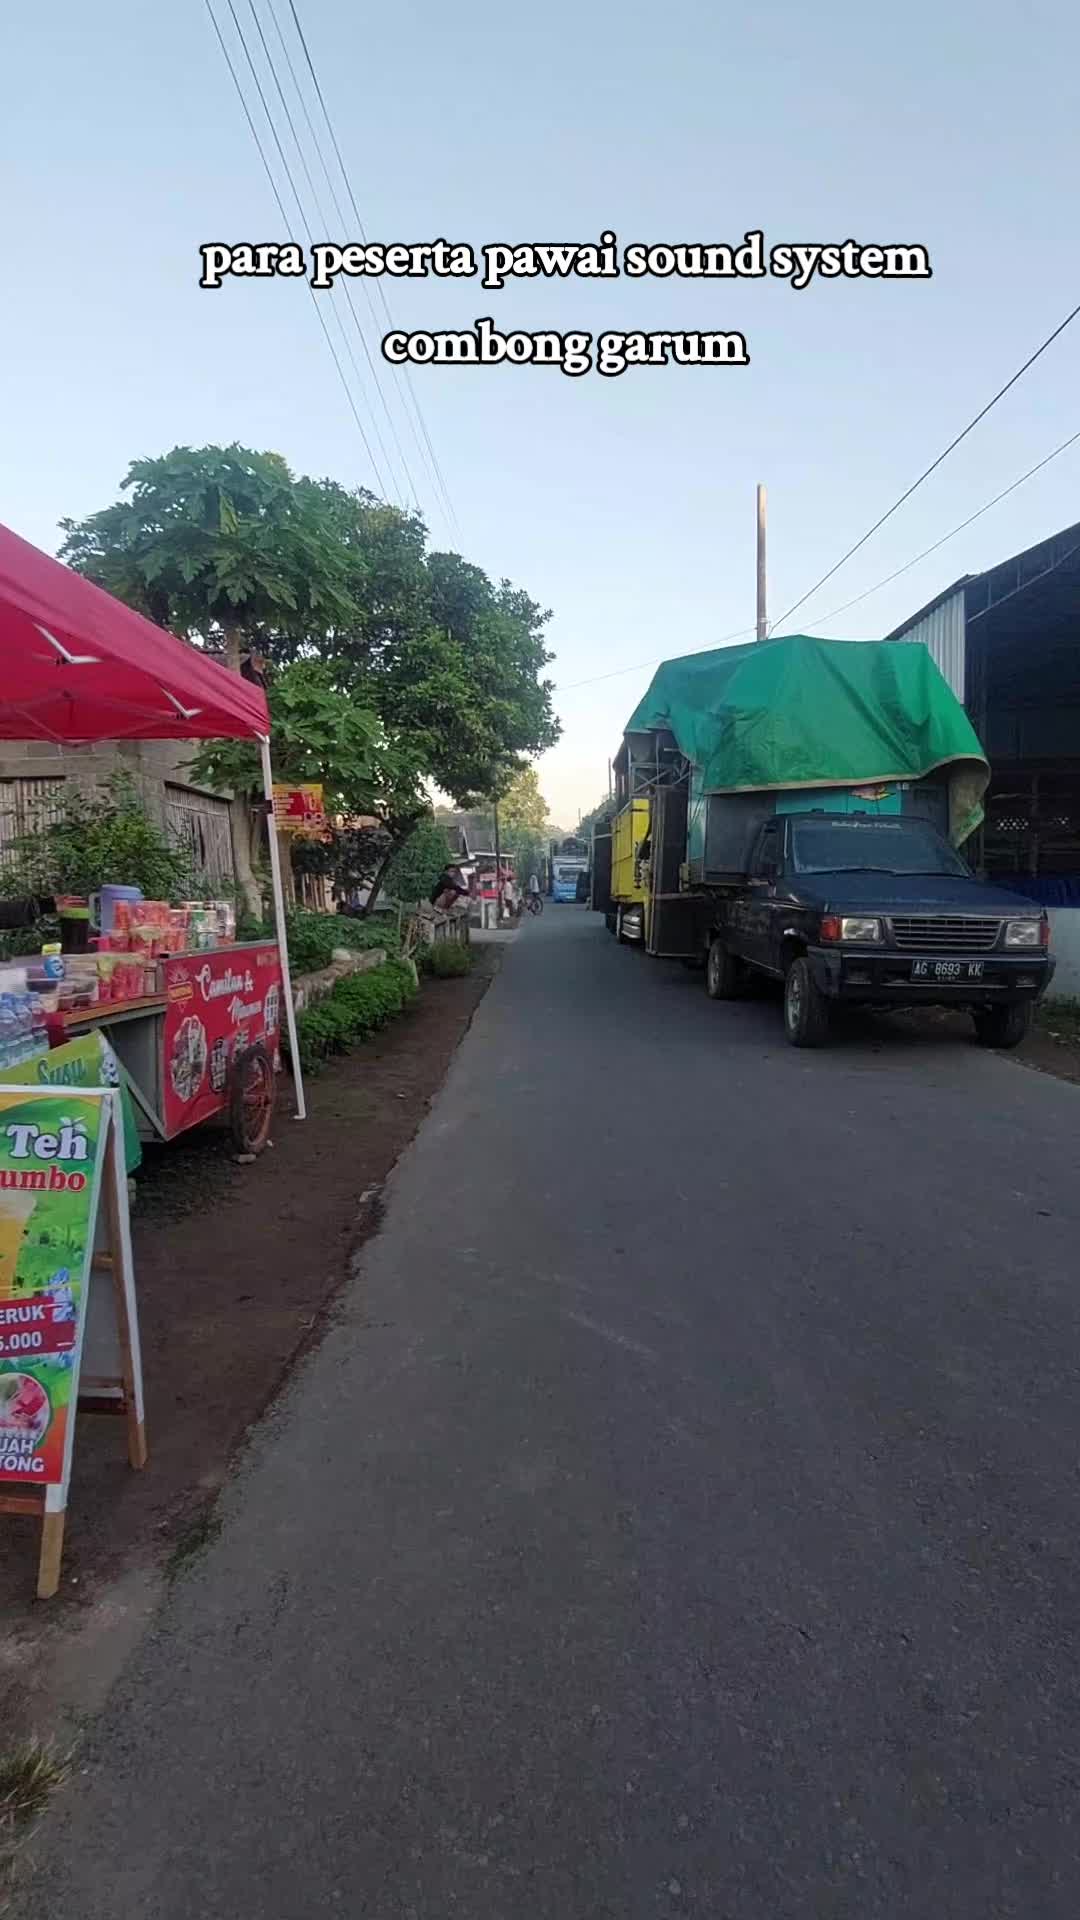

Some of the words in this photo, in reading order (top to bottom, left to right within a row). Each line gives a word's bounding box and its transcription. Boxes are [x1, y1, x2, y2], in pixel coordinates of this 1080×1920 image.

[913, 962, 928, 975] AG
[935, 962, 960, 976] 8693
[968, 961, 983, 976] KK
[6, 1122, 88, 1160] Teh
